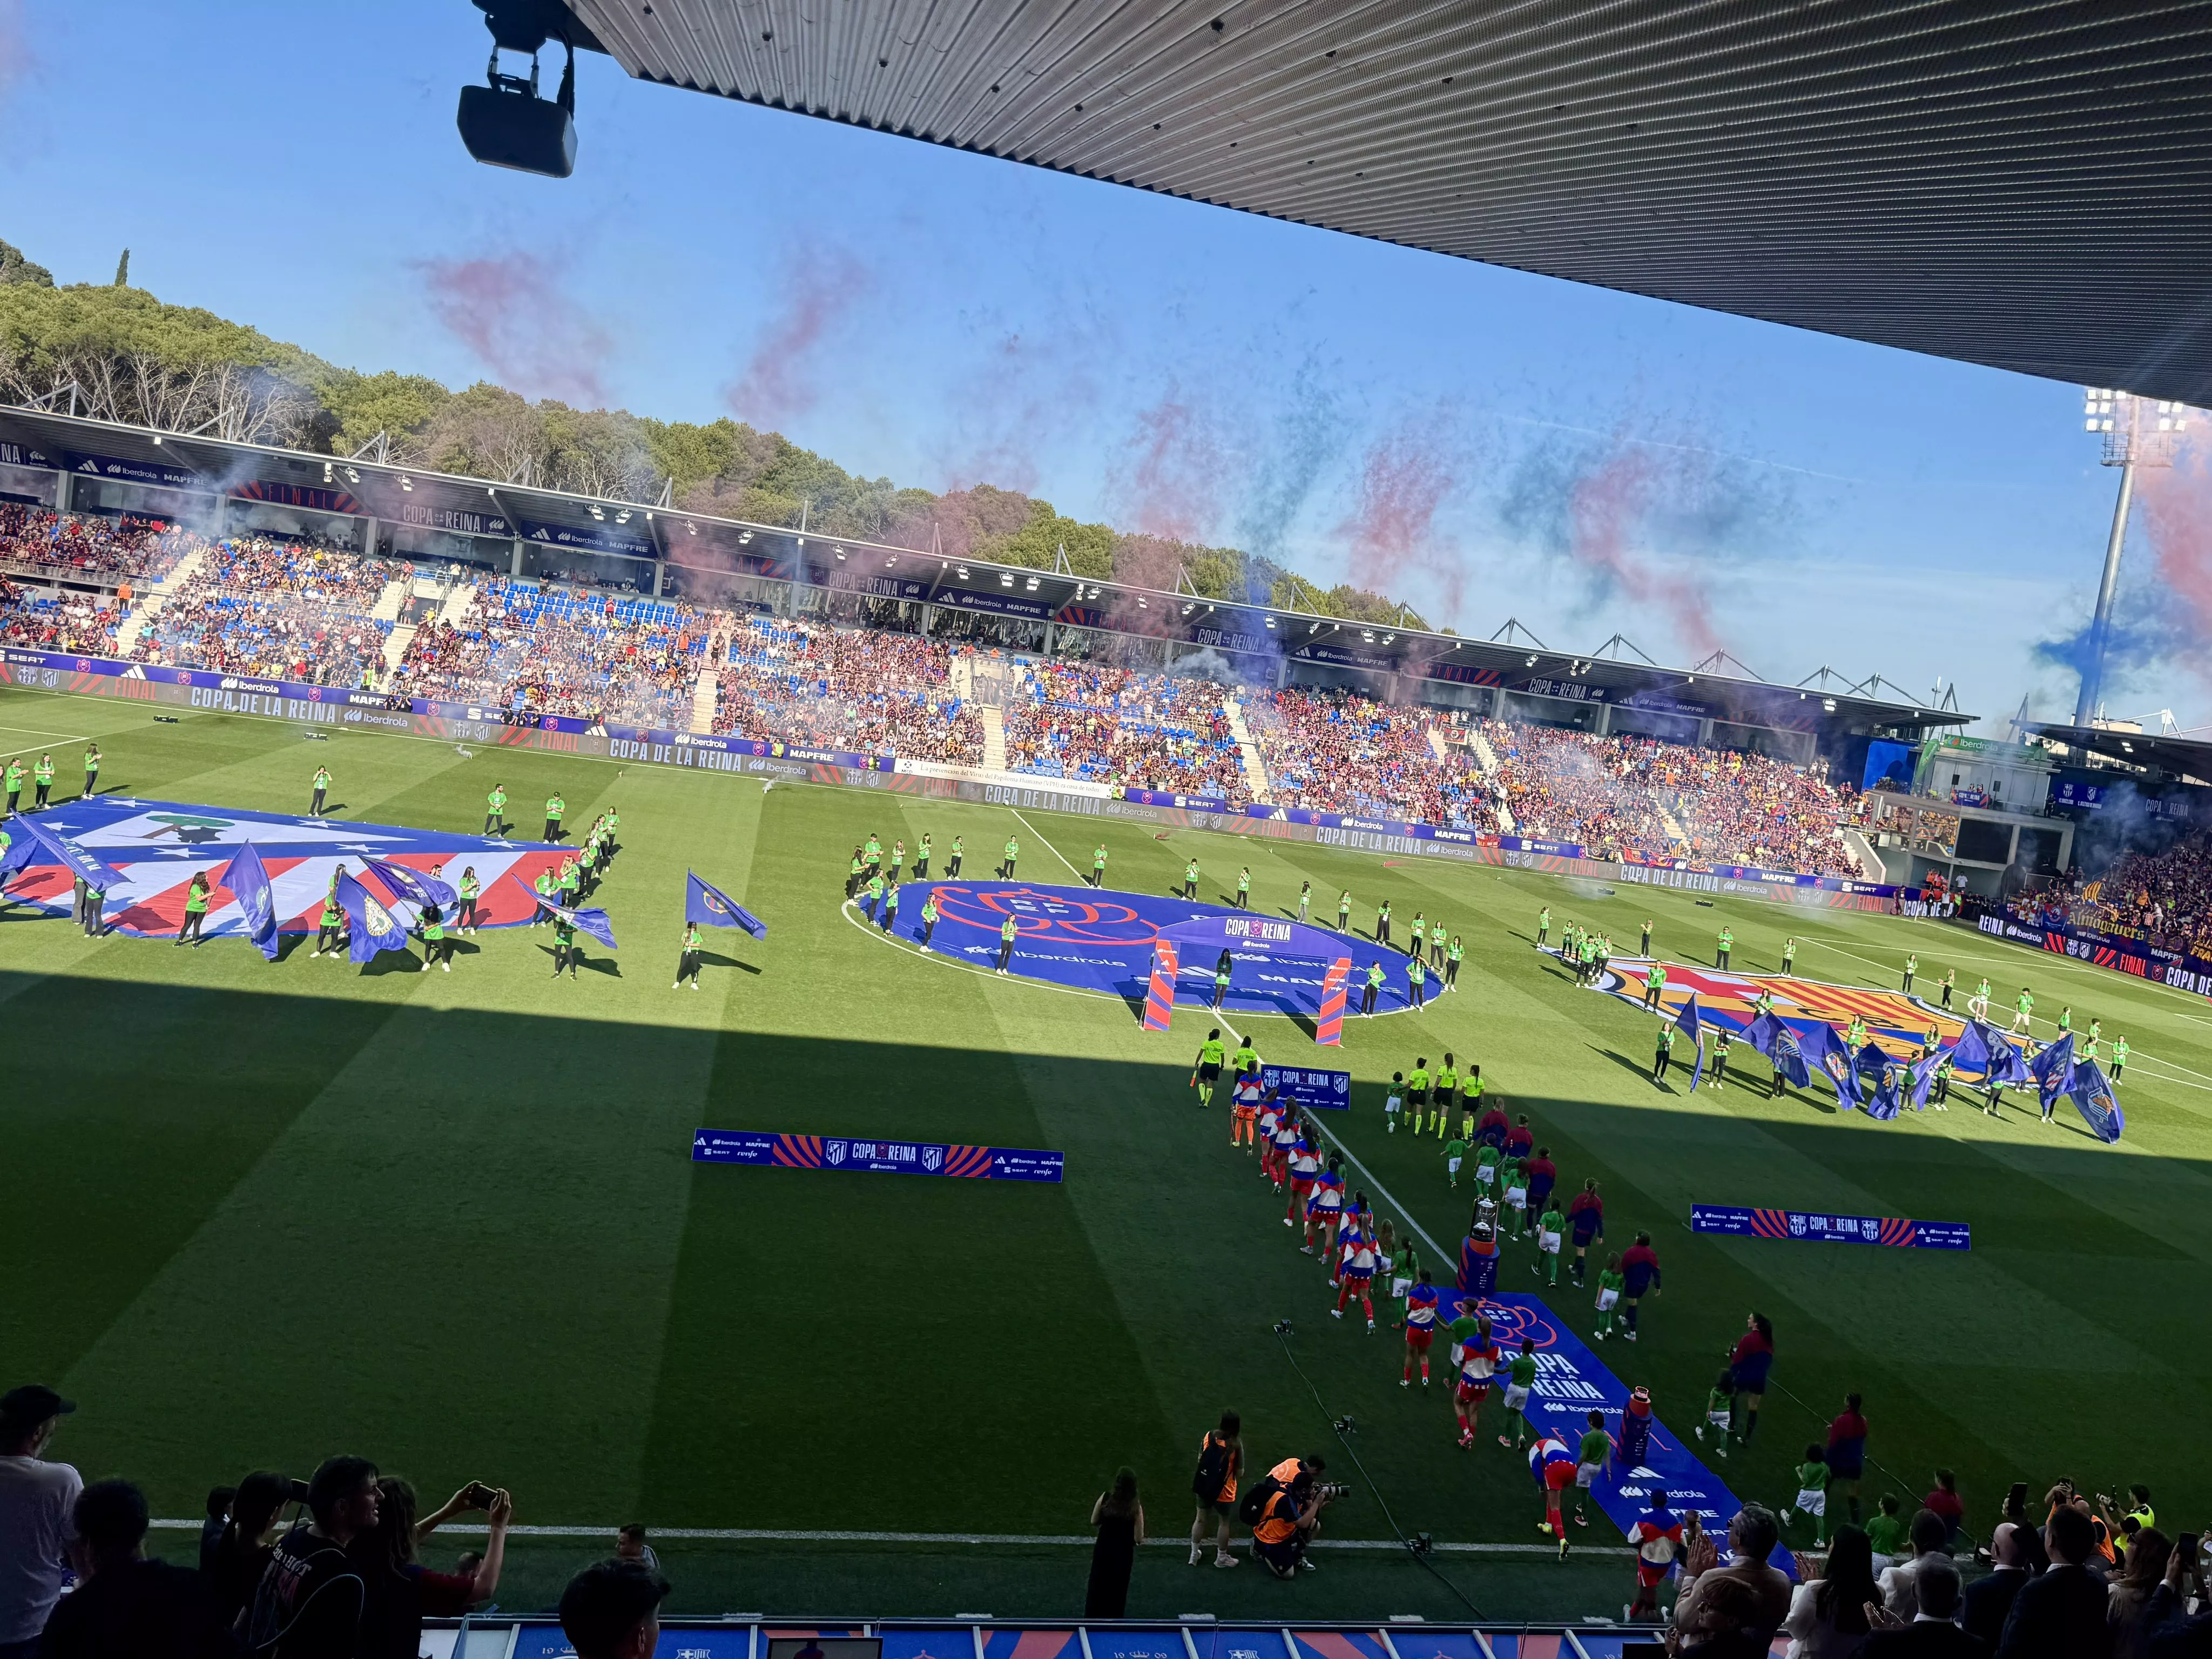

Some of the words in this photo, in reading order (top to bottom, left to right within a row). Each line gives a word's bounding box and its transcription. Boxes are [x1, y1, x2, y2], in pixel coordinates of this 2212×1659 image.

[123, 467, 157, 479] Iberdrola
[268, 484, 329, 509] FINAL
[403, 504, 433, 525] COPA
[446, 510, 481, 532] REINA
[571, 535, 603, 546] Iberdrola
[609, 541, 648, 552] MAPFRE
[828, 571, 855, 590] COPA
[866, 577, 898, 597] REINA
[974, 598, 1002, 608] Iberdrola
[1006, 603, 1041, 614] MAPFRE
[1197, 629, 1222, 645] COPA
[1231, 634, 1260, 651] REINA
[9, 655, 46, 664] SEAT
[1327, 652, 1353, 662] Iberdrola
[1357, 657, 1388, 666] MAPFRE
[114, 679, 157, 700] FINAL
[239, 680, 279, 694] Iberdrola
[1528, 678, 1552, 696] COPA
[1560, 682, 1587, 699] REINA
[191, 687, 233, 710] COPA
[240, 693, 257, 713] DE
[265, 697, 281, 716] LA
[288, 699, 335, 723] REINA
[349, 694, 386, 705] MAPF
[1649, 700, 1673, 709] Iberdrola
[1676, 704, 1705, 713] MAPFRE
[363, 713, 408, 727] Iberdrola
[540, 731, 578, 752] FINAL
[691, 737, 727, 749] Iberdrola
[1960, 739, 1998, 751] Iberdrola
[610, 739, 648, 761] COPA
[654, 743, 670, 763] DE
[676, 746, 692, 766] LA
[699, 749, 741, 771] REINA
[790, 750, 834, 761] MAPFRE
[766, 762, 806, 775] Iberdrola
[929, 767, 959, 775] prevención
[994, 774, 1018, 783] Papiloma
[924, 777, 958, 798] FINAL
[984, 785, 1018, 806] COPA
[1023, 790, 1038, 807] DE
[1043, 793, 1059, 810] LA
[1062, 795, 1100, 815] REINA
[1189, 800, 1216, 808] SEAT
[1122, 806, 1157, 818] Iberdrola
[2146, 799, 2162, 812] COPA
[2169, 802, 2189, 817] REINA
[1262, 820, 1292, 838] FINAL
[1354, 820, 1384, 831] Iberdrola
[1316, 827, 1346, 846] COPA
[1351, 831, 1365, 848] DE
[1369, 834, 1382, 849] LA
[1386, 837, 1421, 854] REINA
[1434, 830, 1472, 841] MAPFRE
[1441, 846, 1473, 857] Iberdrola
[1569, 860, 1599, 877] FINAL
[1620, 866, 1649, 883] COPA
[1653, 869, 1667, 886] DE
[1669, 872, 1682, 888] LA
[1685, 874, 1718, 892] REINA
[1762, 873, 1796, 884] MAPFRE
[1737, 883, 1767, 894] Iberdrola
[1857, 895, 1884, 912] FINAL
[1225, 919, 1249, 936] COPA
[1262, 923, 1290, 941] REINA
[1978, 915, 2003, 935] REINA
[2017, 928, 2042, 943] Iberdrola
[1014, 950, 1127, 967] Iberdrola
[2190, 946, 2212, 963] FRA
[2120, 954, 2146, 977] FINAL
[2166, 967, 2195, 991] COPA
[2197, 976, 2212, 996] DE
[1283, 1071, 1299, 1083] COPA
[1309, 1073, 1328, 1086] REINA
[852, 1143, 876, 1159] COPA
[888, 1145, 916, 1162] REINA
[1810, 1216, 1827, 1230] COPA
[1836, 1218, 1858, 1232] REINA
